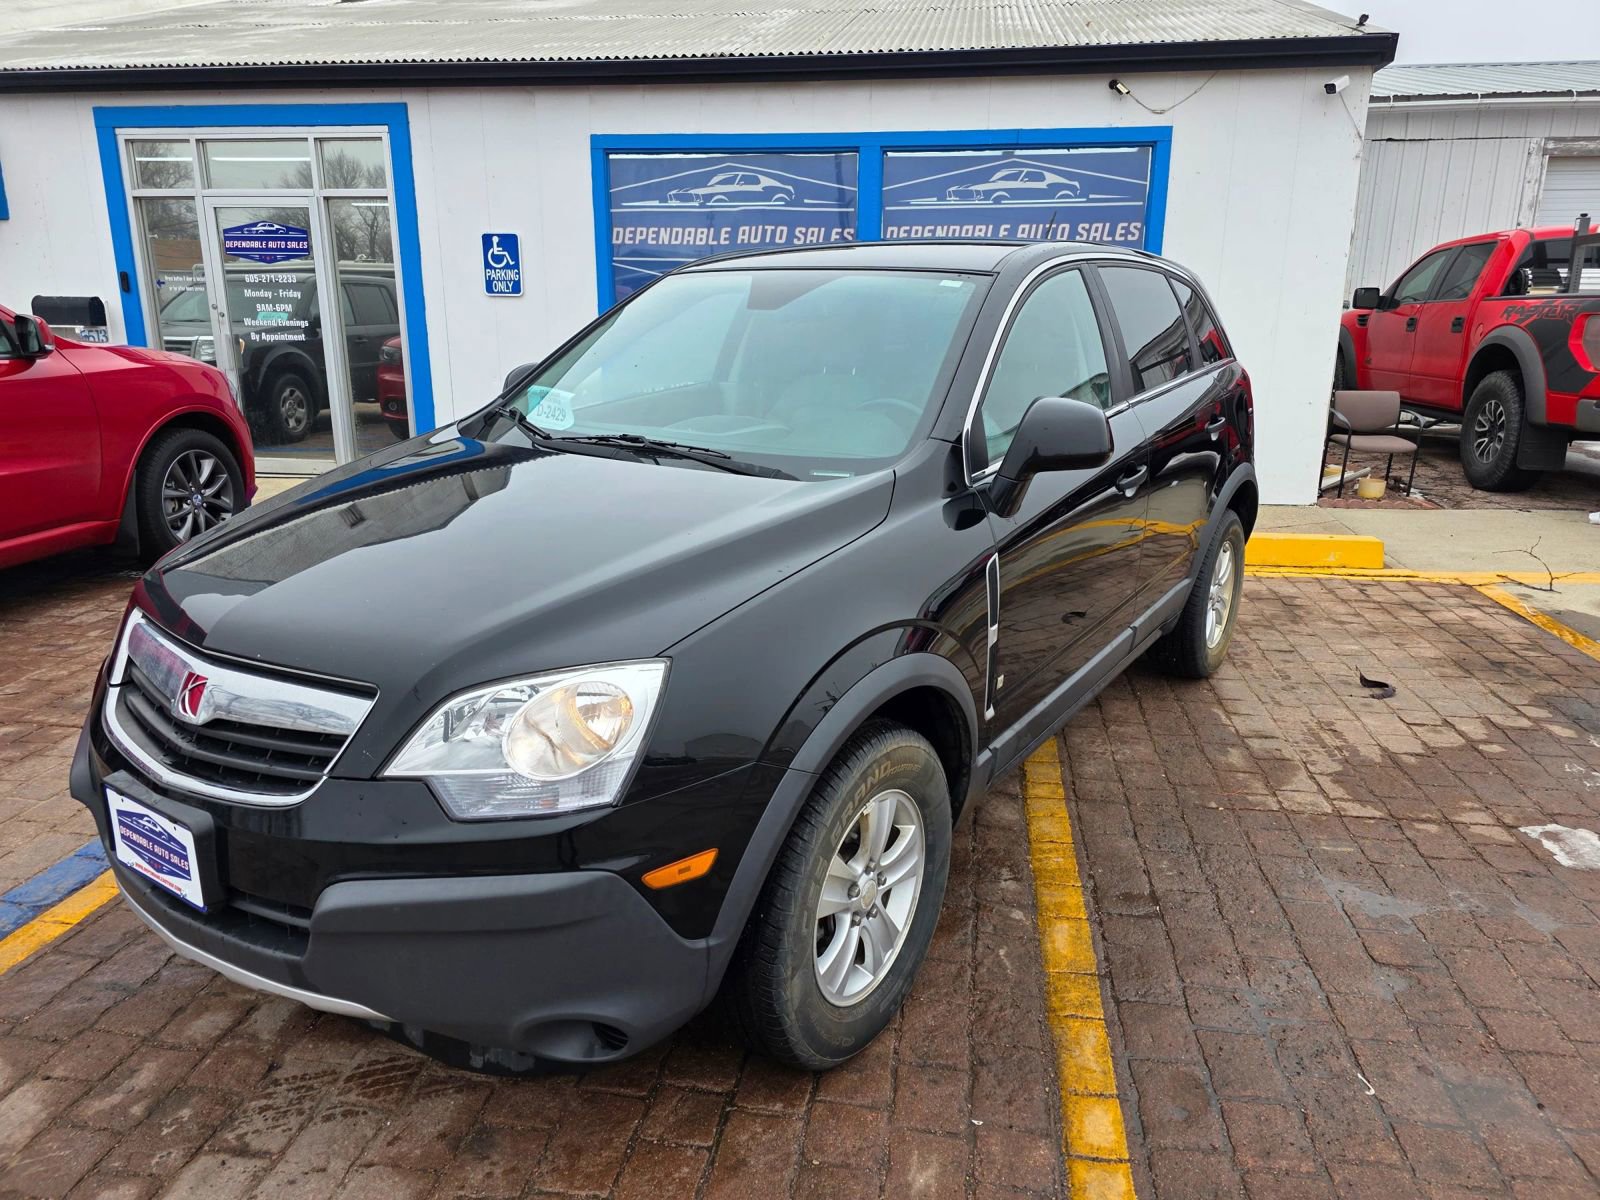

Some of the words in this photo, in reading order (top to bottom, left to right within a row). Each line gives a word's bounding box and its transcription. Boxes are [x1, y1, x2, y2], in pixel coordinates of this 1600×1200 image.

[612, 227, 731, 245] DEPENDABLE
[737, 225, 787, 244] AUTO
[793, 227, 855, 244] SALES
[886, 224, 1011, 238] DEPENDABLE
[1016, 223, 1070, 240] AUTO
[1076, 222, 1142, 241] SALES
[268, 241, 286, 249] AUTO
[287, 241, 308, 249] SALES
[245, 274, 297, 283] 605-271-2233
[486, 269, 519, 281] PARKING
[492, 281, 513, 292] ONLY
[244, 289, 272, 299] Monday
[279, 289, 301, 299] Friday
[256, 303, 292, 312] 9AM-6PM
[250, 332, 260, 342] By
[261, 332, 306, 342] Appointment
[537, 404, 567, 422] D-2429
[120, 825, 153, 850] DEPENDABLE
[154, 844, 169, 859] AUTO
[170, 853, 188, 868] SALES
